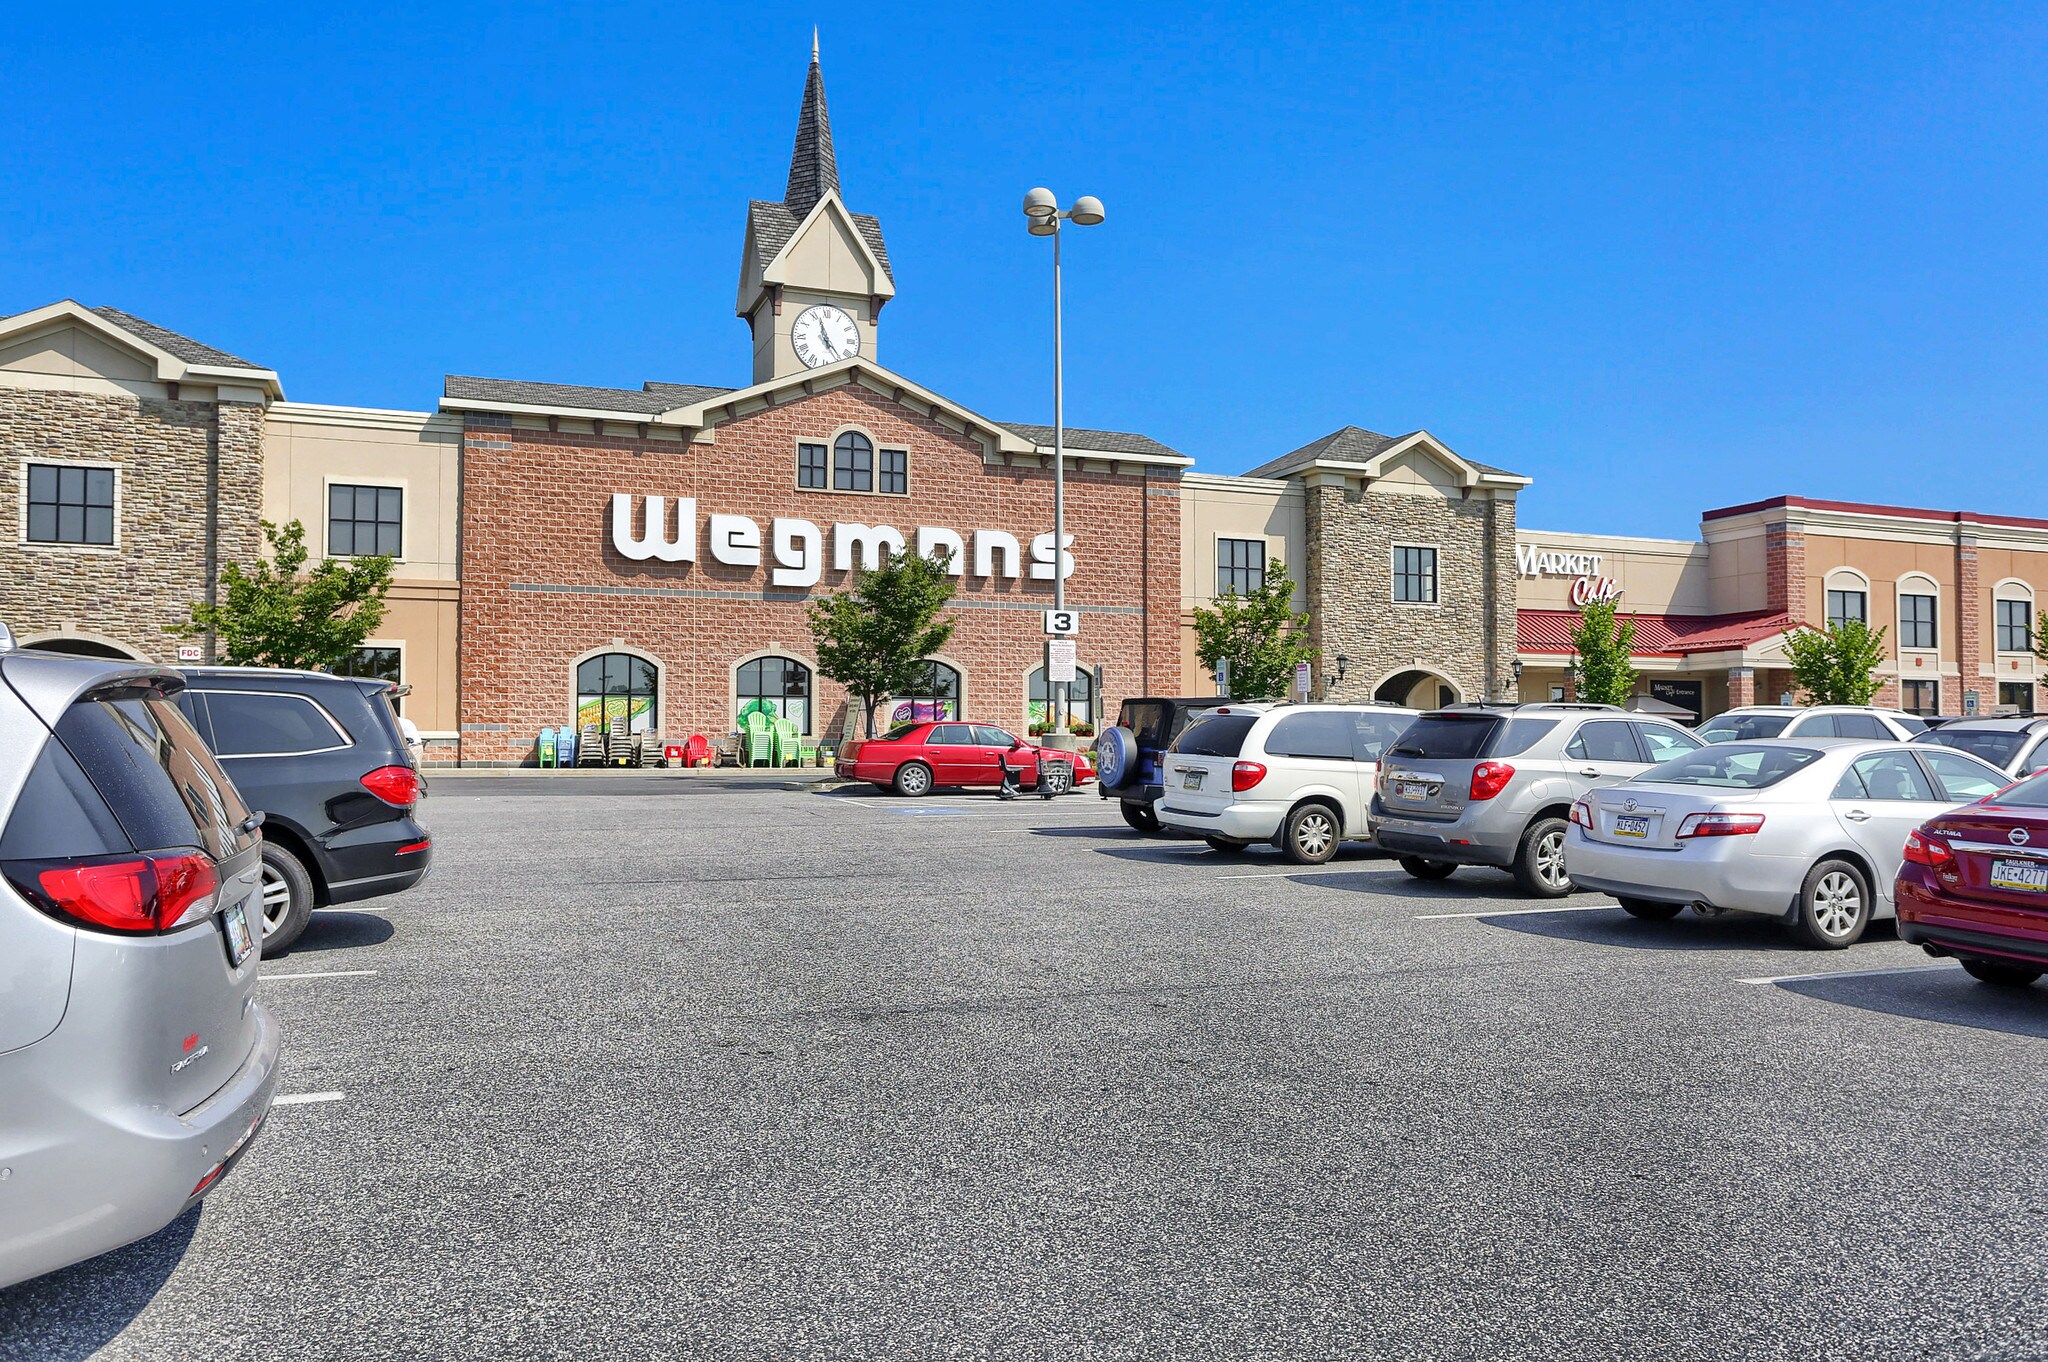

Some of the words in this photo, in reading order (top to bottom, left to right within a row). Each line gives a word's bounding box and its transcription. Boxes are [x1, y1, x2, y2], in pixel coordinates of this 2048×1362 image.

[611, 493, 1075, 588] Wegmans
[1516, 544, 1603, 576] MARKET
[1054, 612, 1071, 631] 3
[181, 649, 199, 657] FDC
[1933, 829, 1962, 838] ALTIMA
